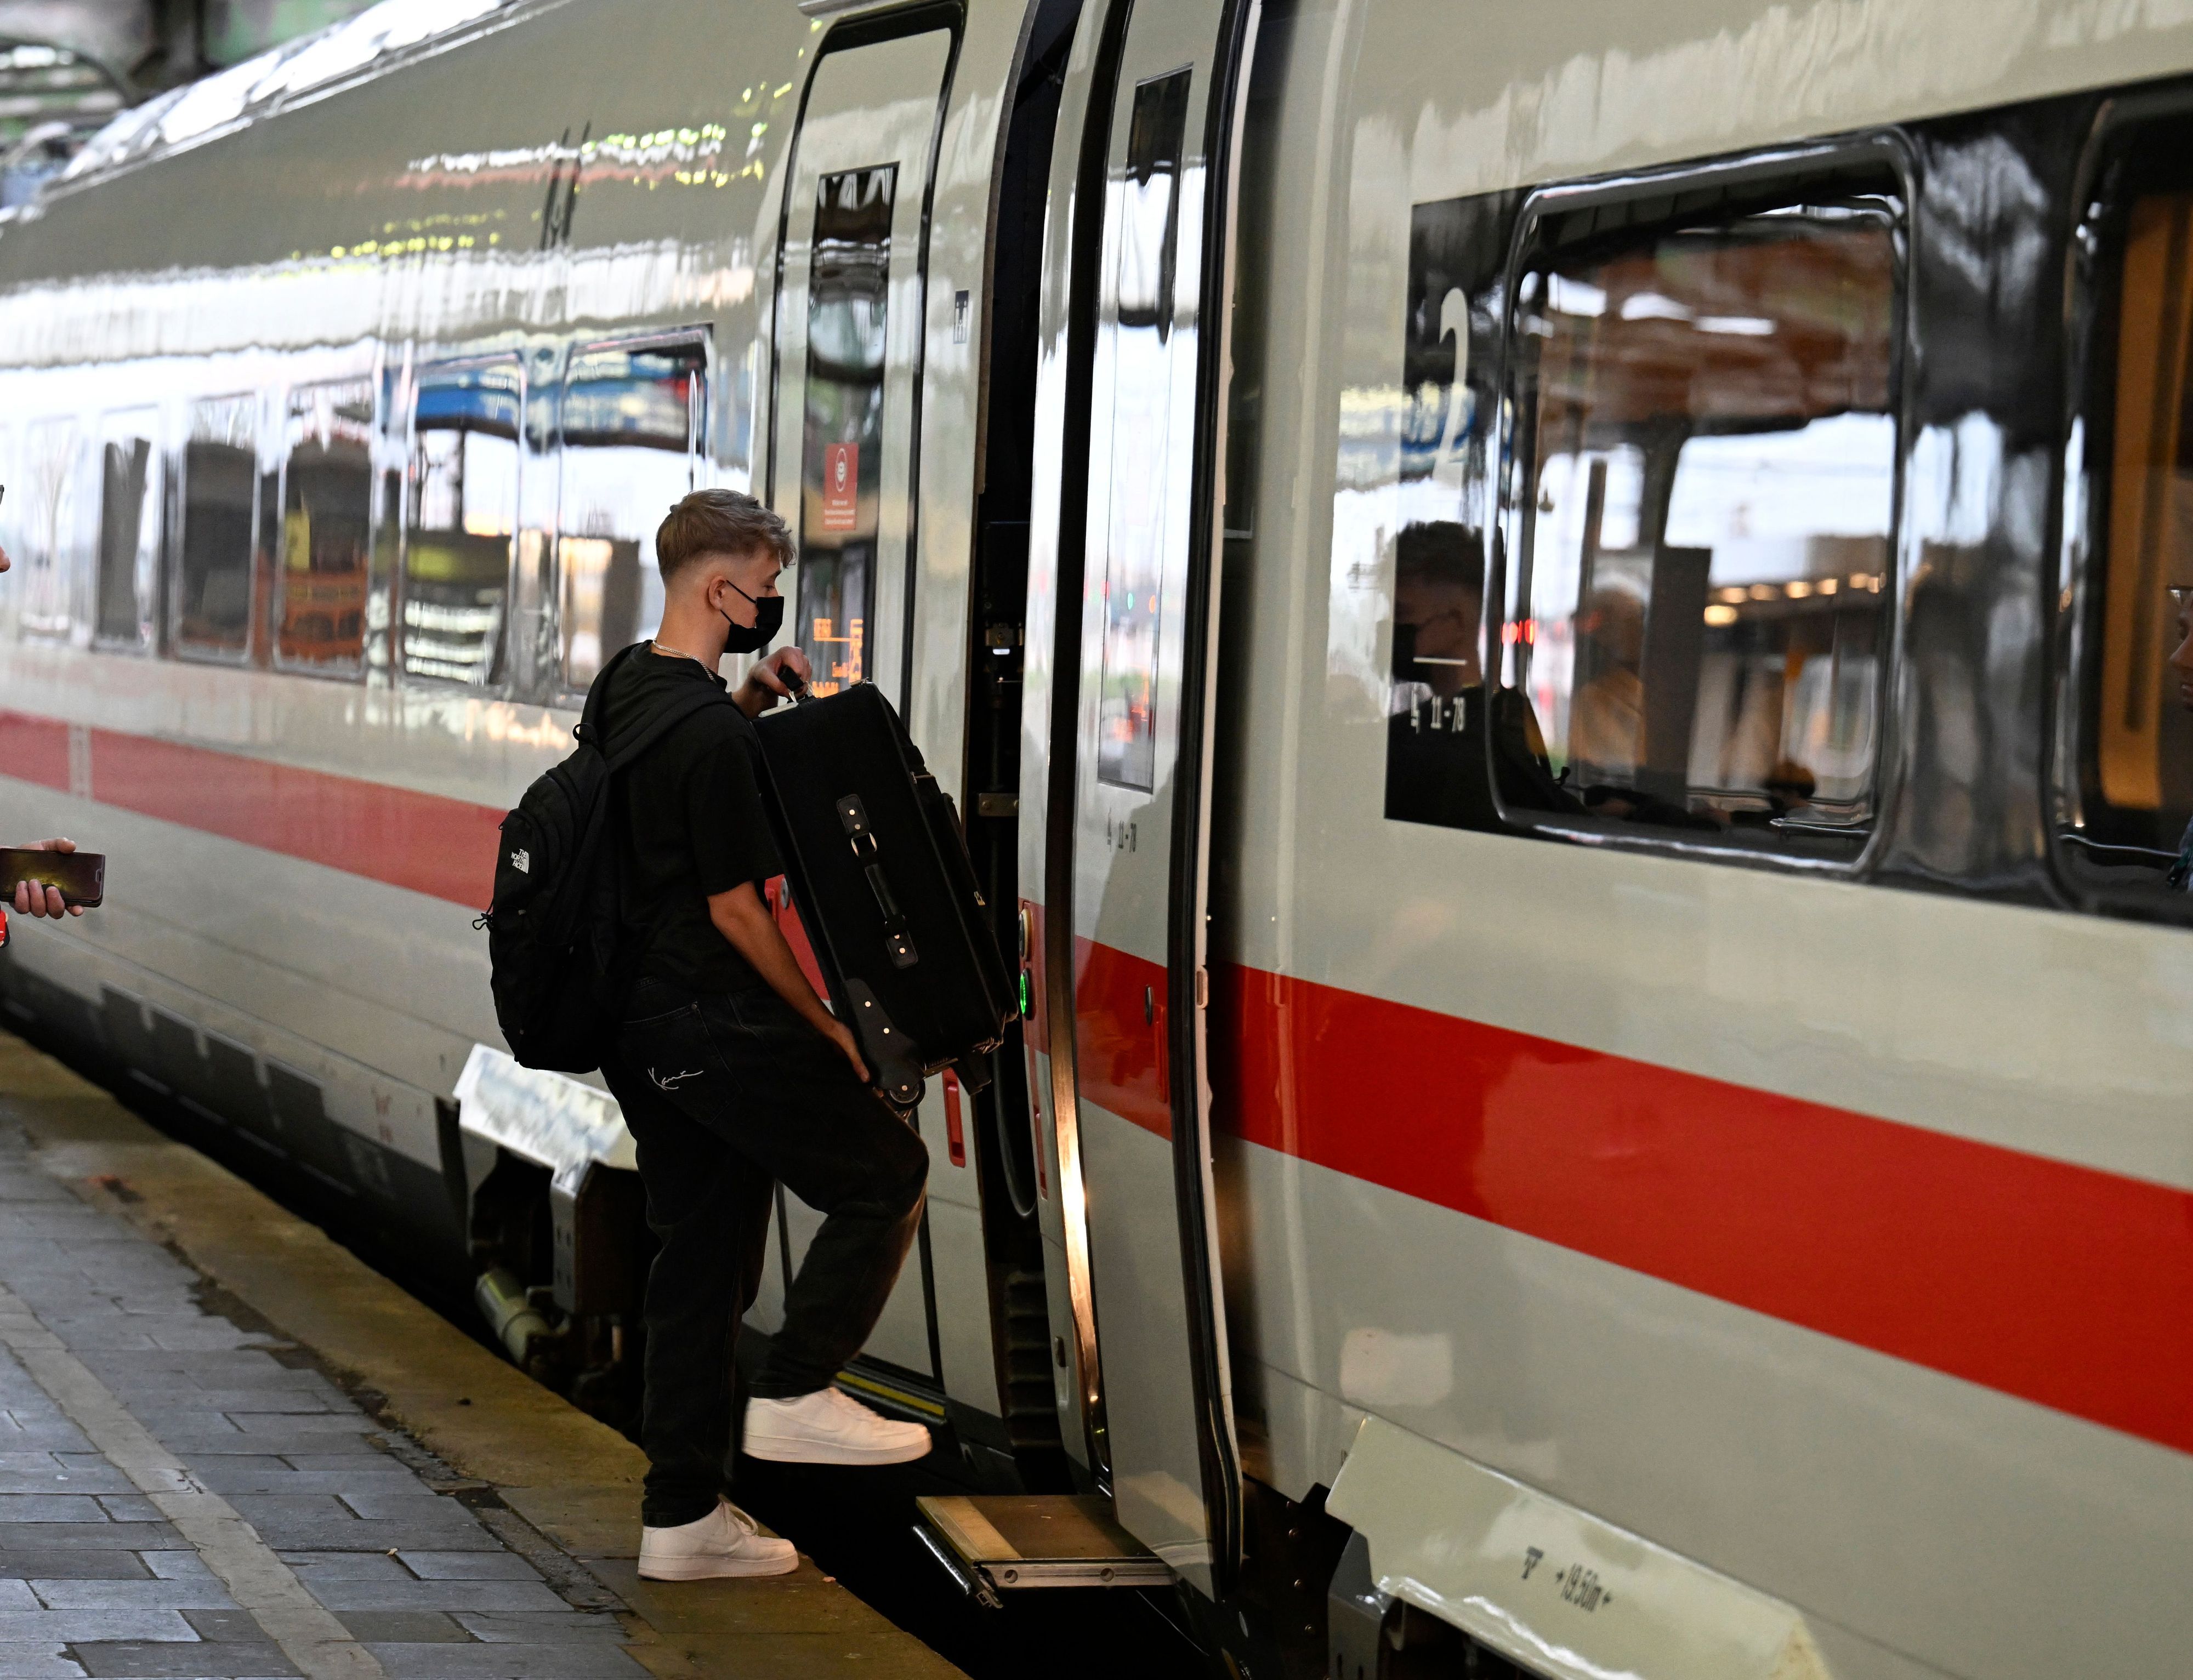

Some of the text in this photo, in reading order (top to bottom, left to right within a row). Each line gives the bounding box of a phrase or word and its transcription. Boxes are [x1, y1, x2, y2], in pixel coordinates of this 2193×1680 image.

[1431, 286, 1469, 503] 2
[510, 851, 525, 864] NORTH
[519, 848, 527, 859] THE
[512, 859, 524, 870] FACE
